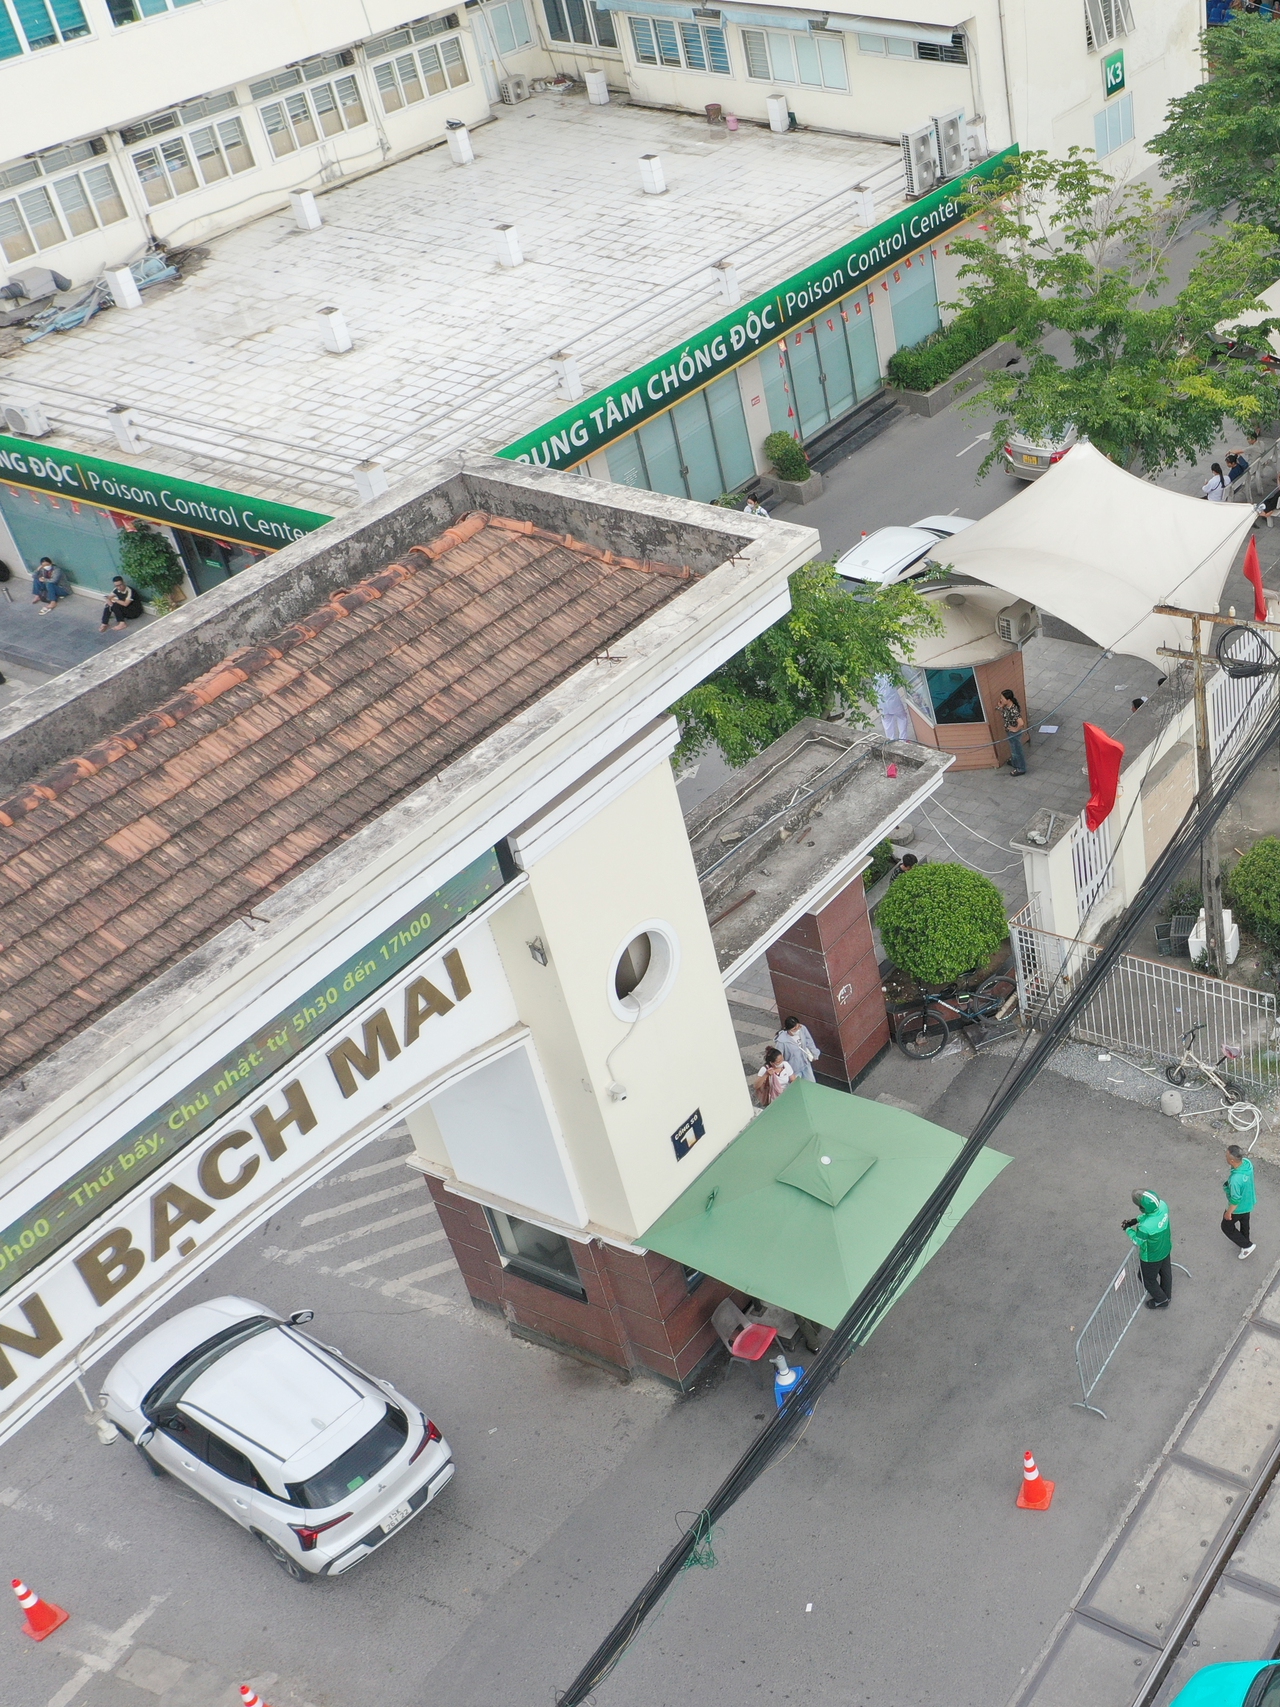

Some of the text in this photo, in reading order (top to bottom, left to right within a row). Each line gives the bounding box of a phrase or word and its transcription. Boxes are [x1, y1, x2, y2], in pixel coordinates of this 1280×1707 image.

[1106, 62, 1123, 88] K3
[589, 387, 644, 434] TÂM
[647, 336, 727, 400] CHỐNG
[730, 305, 776, 351] ĐỘC
[785, 269, 844, 316] Poison
[847, 225, 906, 277] Control
[910, 199, 958, 238] Center
[28, 456, 79, 487] ĐỘC
[87, 471, 158, 506] Poison
[160, 490, 239, 527] Control
[242, 511, 310, 541] Cente
[68, 1165, 115, 1207] Thứ
[168, 1091, 210, 1130] Chủ
[213, 1050, 264, 1096] nhật:
[266, 1025, 289, 1052] từ
[292, 987, 338, 1033] 5h30
[342, 960, 377, 993] đến
[379, 912, 432, 961] 17h00
[73, 1079, 318, 1307] BẠCH
[325, 947, 472, 1099] MAI
[680, 1127, 697, 1148] 1
[386, 1509, 410, 1530] 261.22
[388, 1509, 401, 1520] 15K
